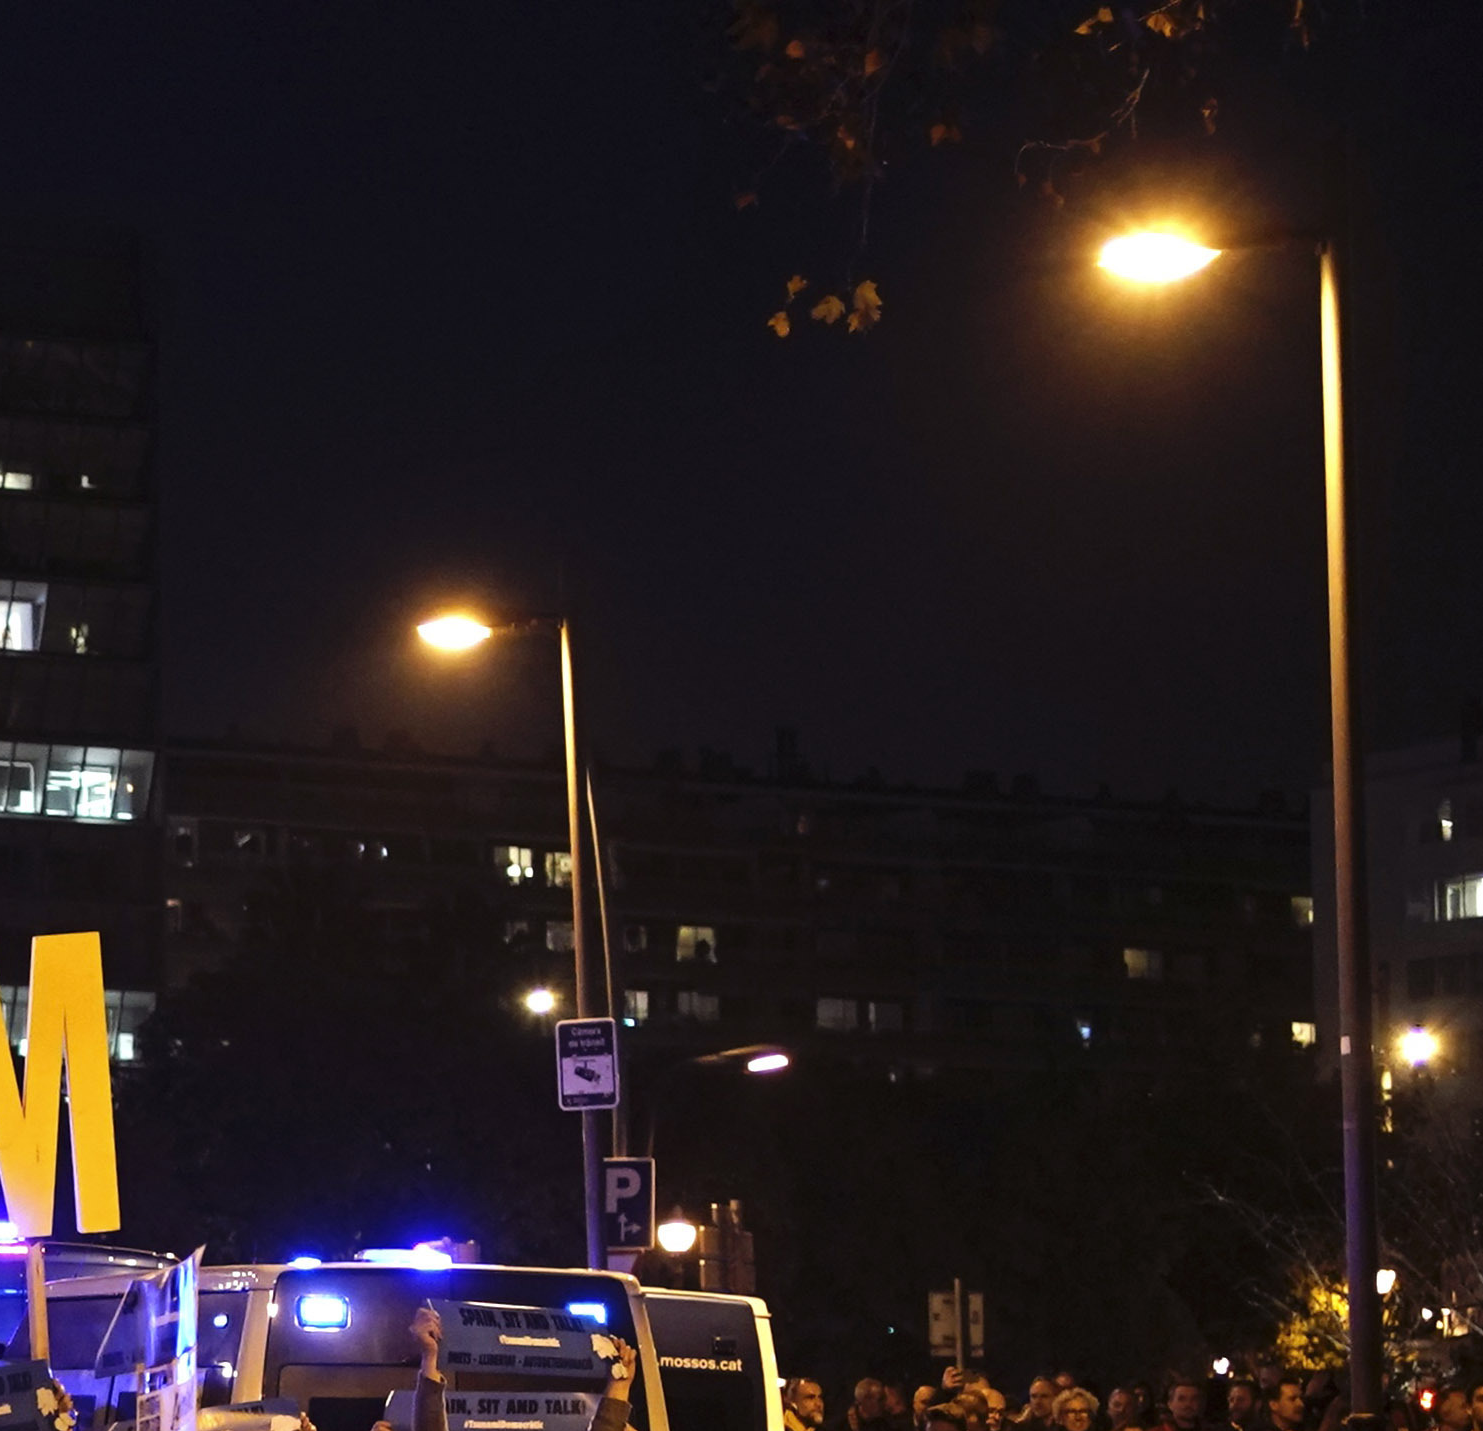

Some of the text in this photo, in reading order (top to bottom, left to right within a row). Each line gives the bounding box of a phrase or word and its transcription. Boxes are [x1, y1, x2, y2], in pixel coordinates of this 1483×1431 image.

[605, 1167, 642, 1213] P
[477, 1398, 501, 1415] SIT
[505, 1399, 539, 1416] AND
